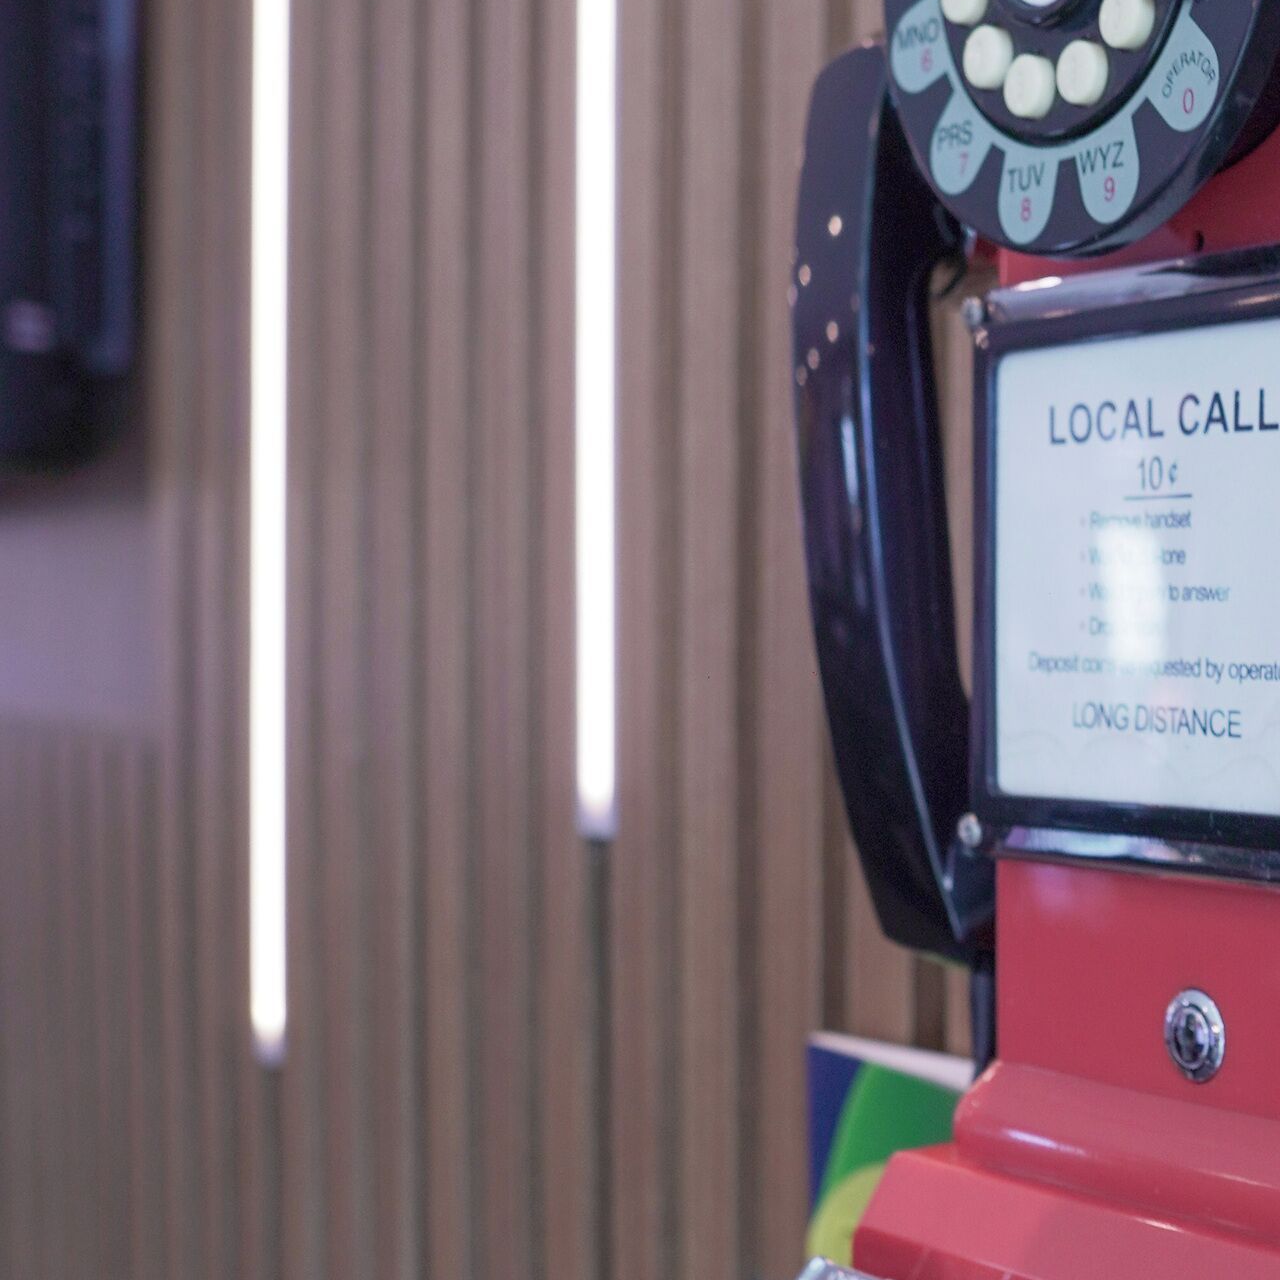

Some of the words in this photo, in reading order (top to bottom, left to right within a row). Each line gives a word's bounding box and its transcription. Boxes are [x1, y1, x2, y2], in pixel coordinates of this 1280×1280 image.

[899, 17, 940, 52] MNO
[920, 47, 933, 73] 6
[1160, 50, 1217, 100] OPERATOR
[936, 122, 974, 152] PRS
[959, 151, 970, 176] 7
[1078, 140, 1126, 177] WYZ
[1007, 161, 1046, 195] TUV
[1103, 175, 1117, 202] 9
[1019, 196, 1033, 223] 8
[1048, 396, 1165, 445] LOCAL
[1178, 387, 1280, 436] CALL
[1144, 510, 1193, 530] handset
[1181, 585, 1231, 602] answer
[1028, 651, 1079, 675] Deposit
[1205, 657, 1225, 683] by
[1071, 700, 1131, 732] LONG
[1134, 704, 1243, 739] DISTANCE
